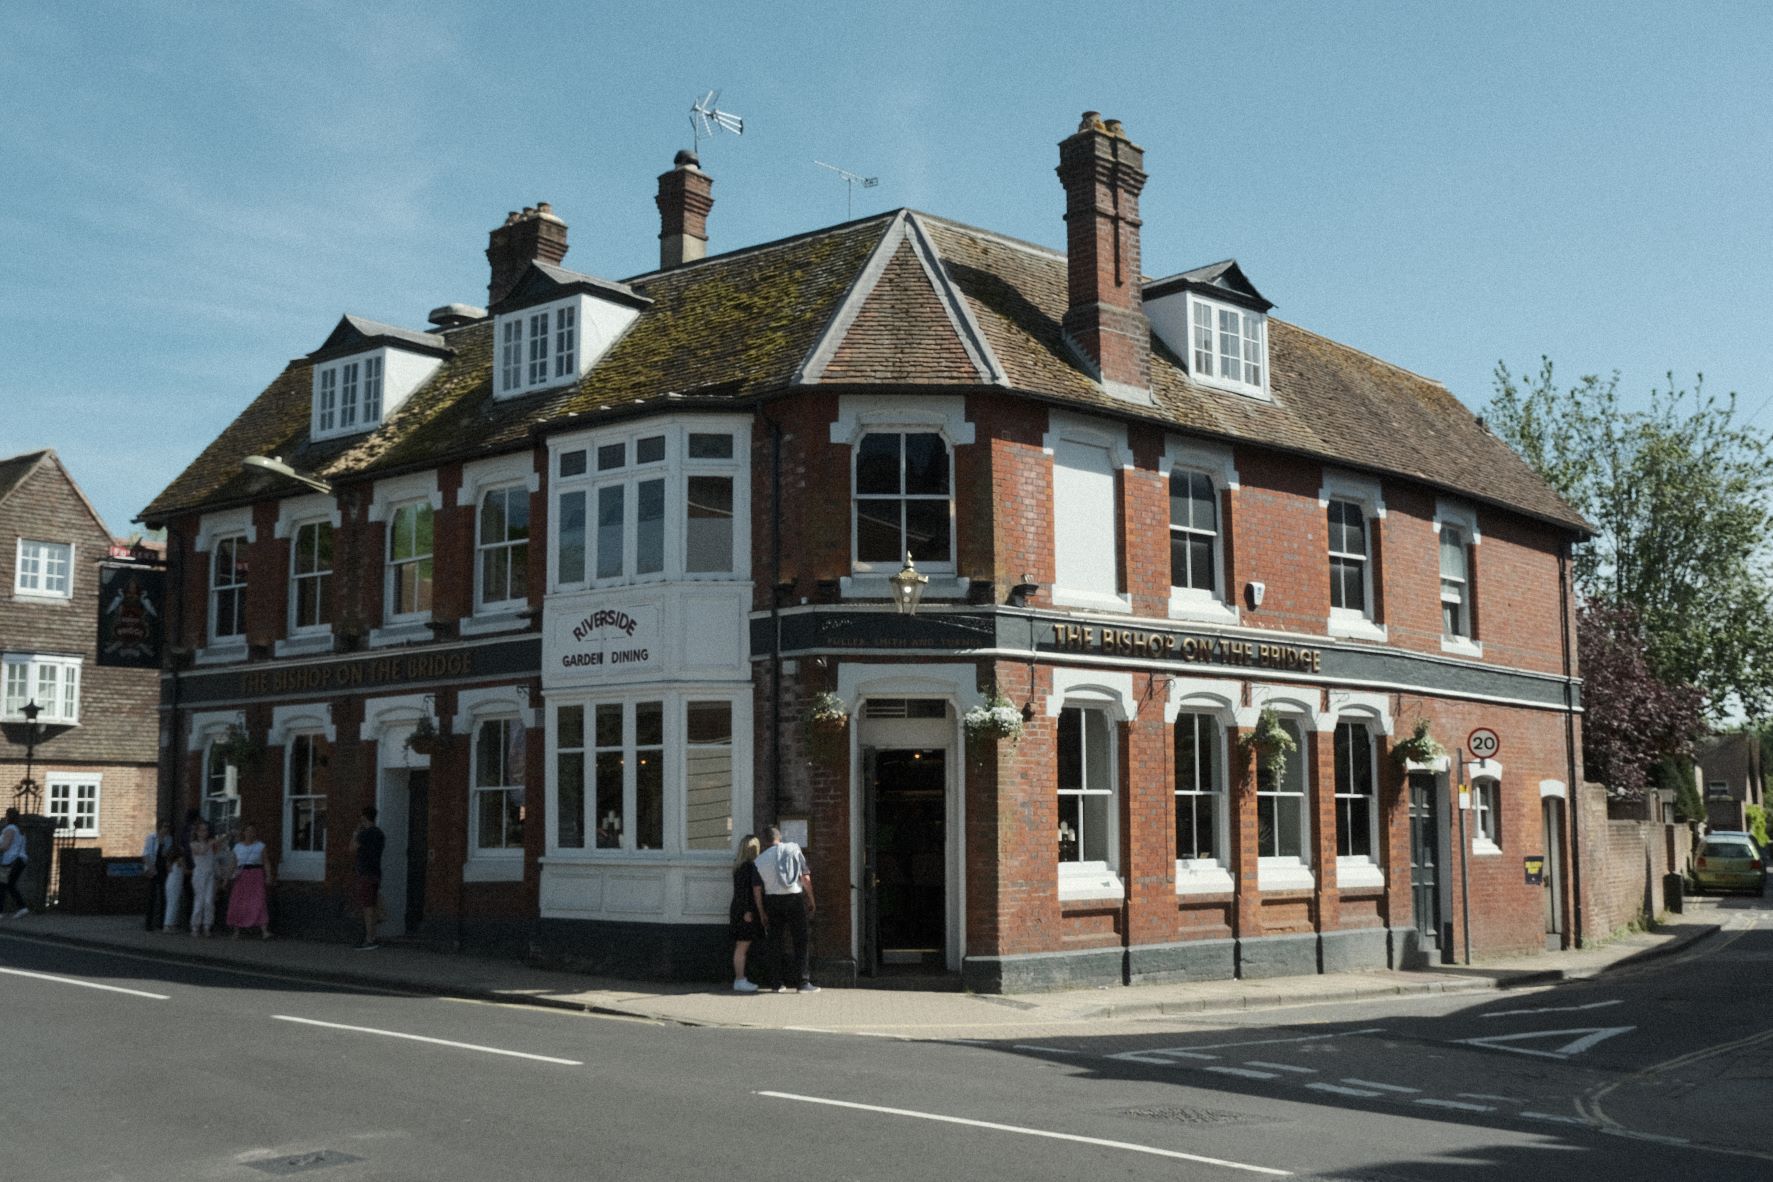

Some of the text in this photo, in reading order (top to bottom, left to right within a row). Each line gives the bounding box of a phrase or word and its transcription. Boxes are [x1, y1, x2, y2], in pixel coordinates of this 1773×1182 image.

[572, 610, 637, 642] RIVERSIDE
[562, 648, 649, 668] GARDEN DINING
[1053, 623, 1321, 673] THE BISHOP ON THE BRIDGE
[239, 654, 471, 694] THE BISHOP ON THE BRIDGE
[1473, 737, 1495, 750] 20
